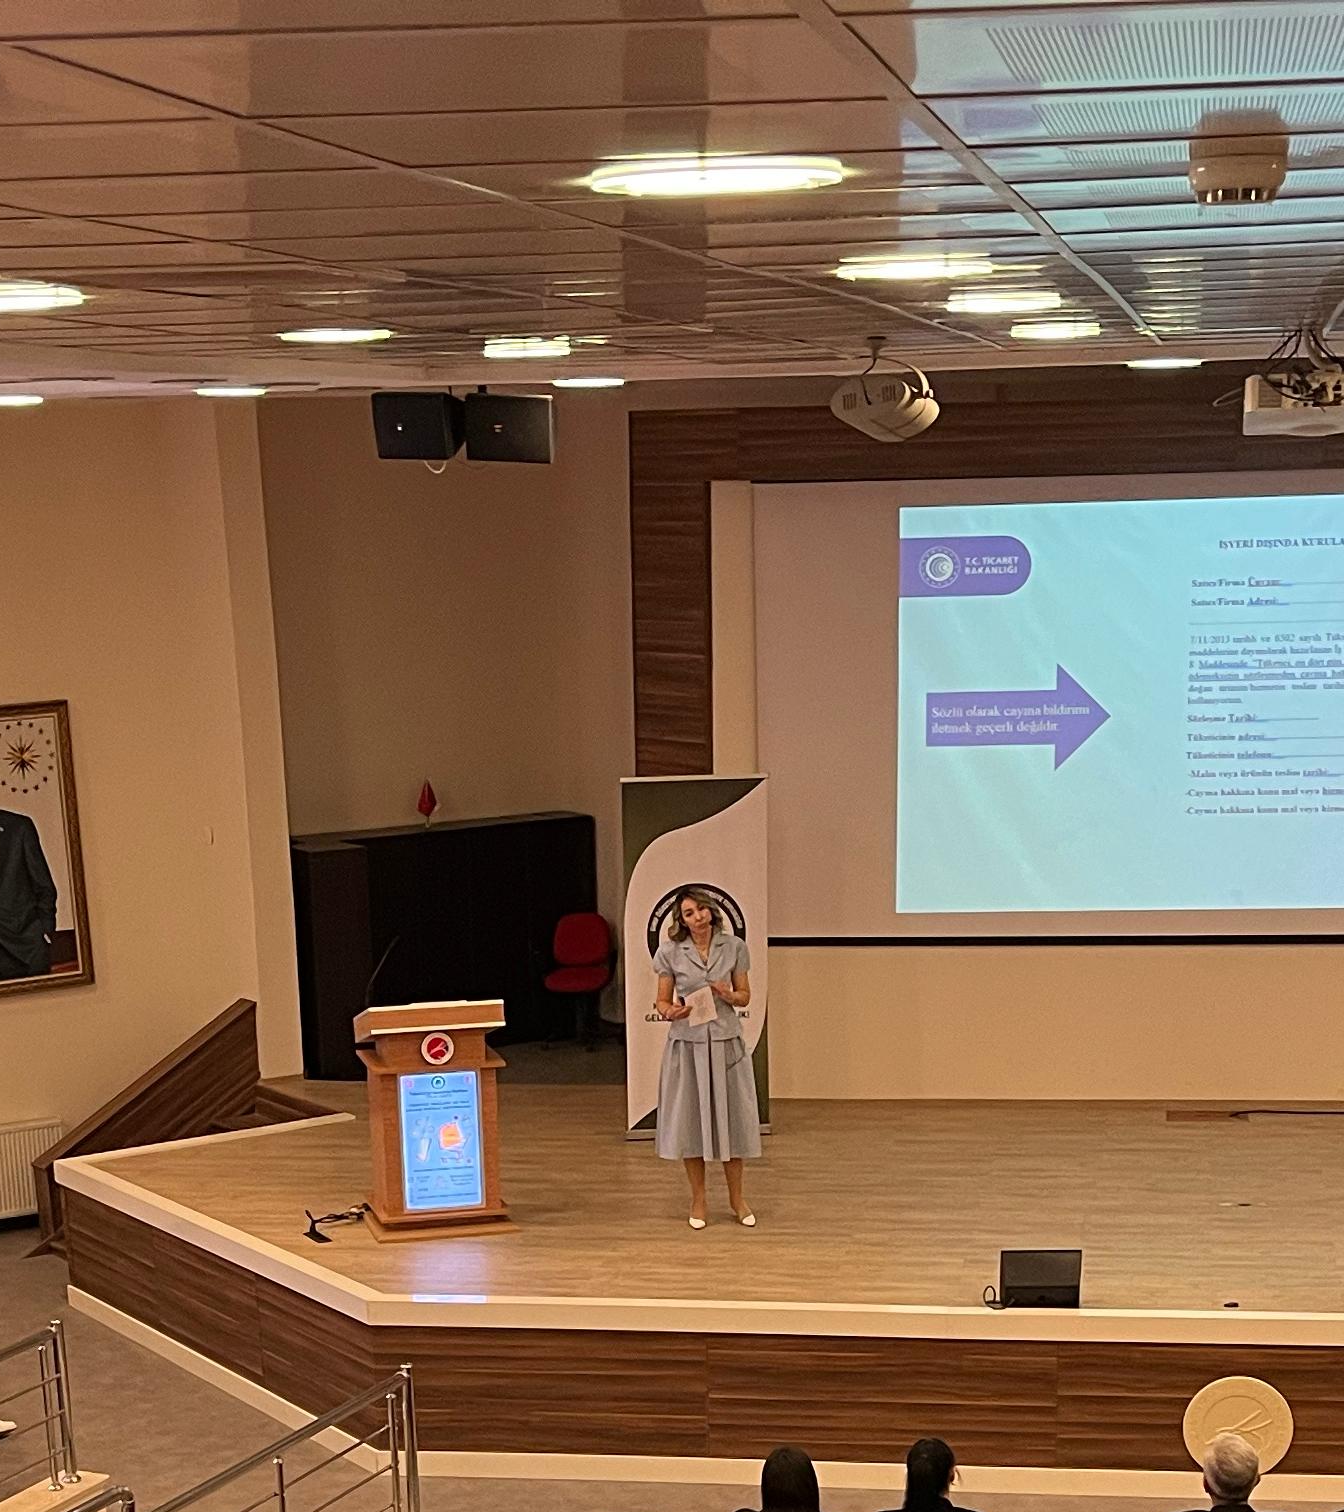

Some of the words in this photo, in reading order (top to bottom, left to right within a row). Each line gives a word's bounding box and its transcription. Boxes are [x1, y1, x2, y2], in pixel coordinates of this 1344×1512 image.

[965, 704, 1001, 717] olarak
[1003, 707, 1042, 720] cayma
[975, 721, 1014, 736] geçerli
